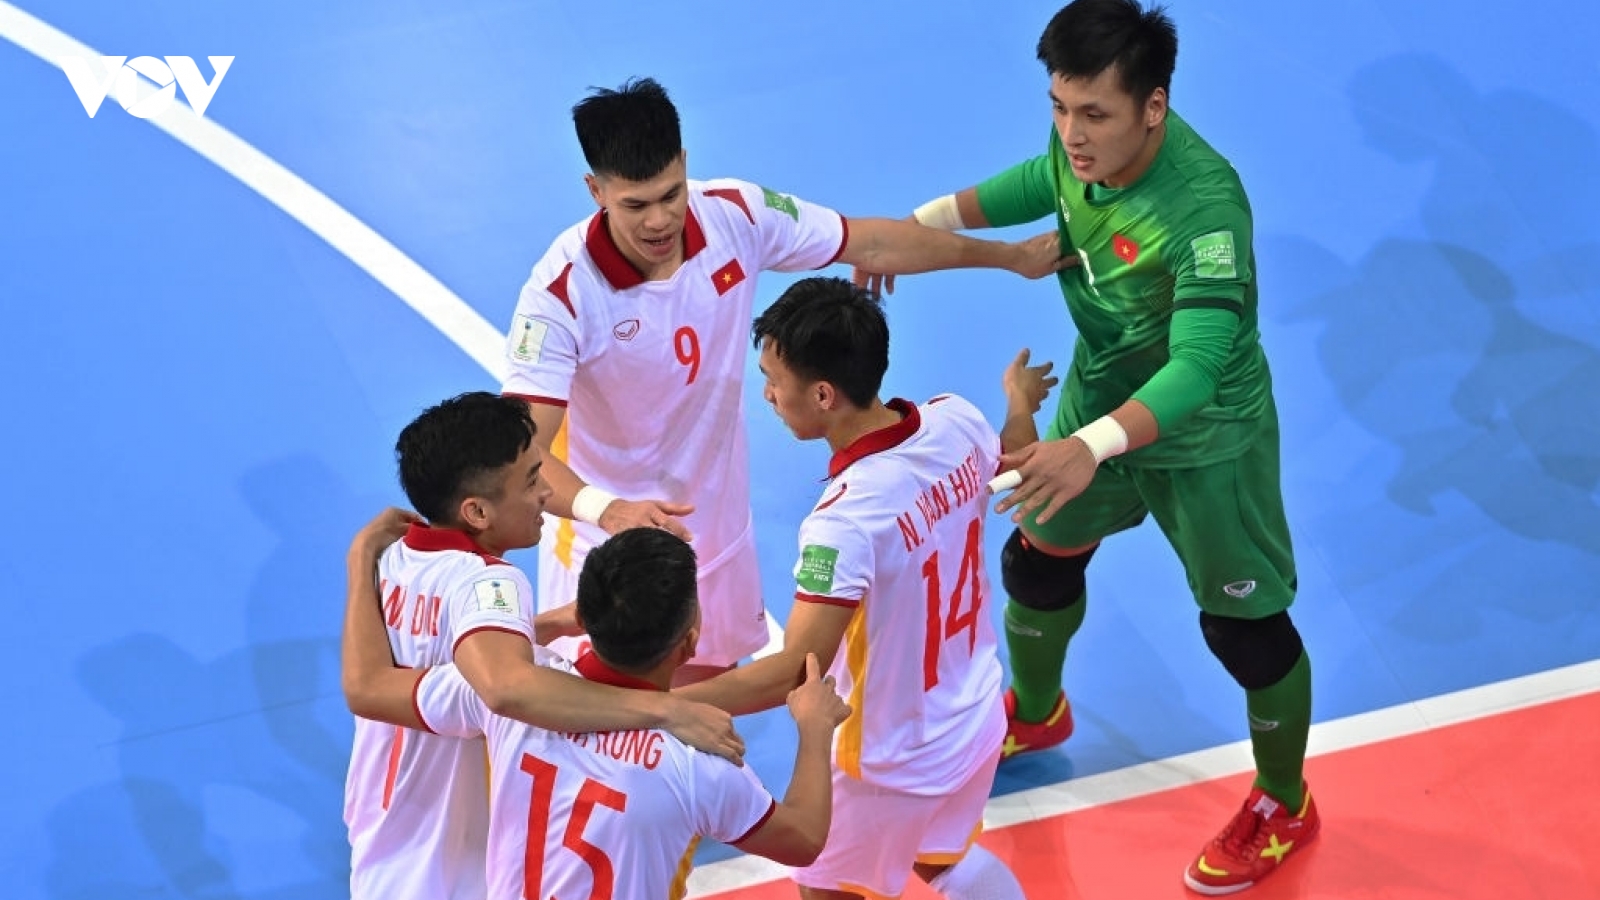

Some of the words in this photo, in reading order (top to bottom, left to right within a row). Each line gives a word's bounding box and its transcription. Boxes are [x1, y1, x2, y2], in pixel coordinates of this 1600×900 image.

[673, 326, 700, 386] 9
[896, 511, 925, 552] N.
[921, 517, 983, 692] 14
[520, 752, 627, 900] 15
